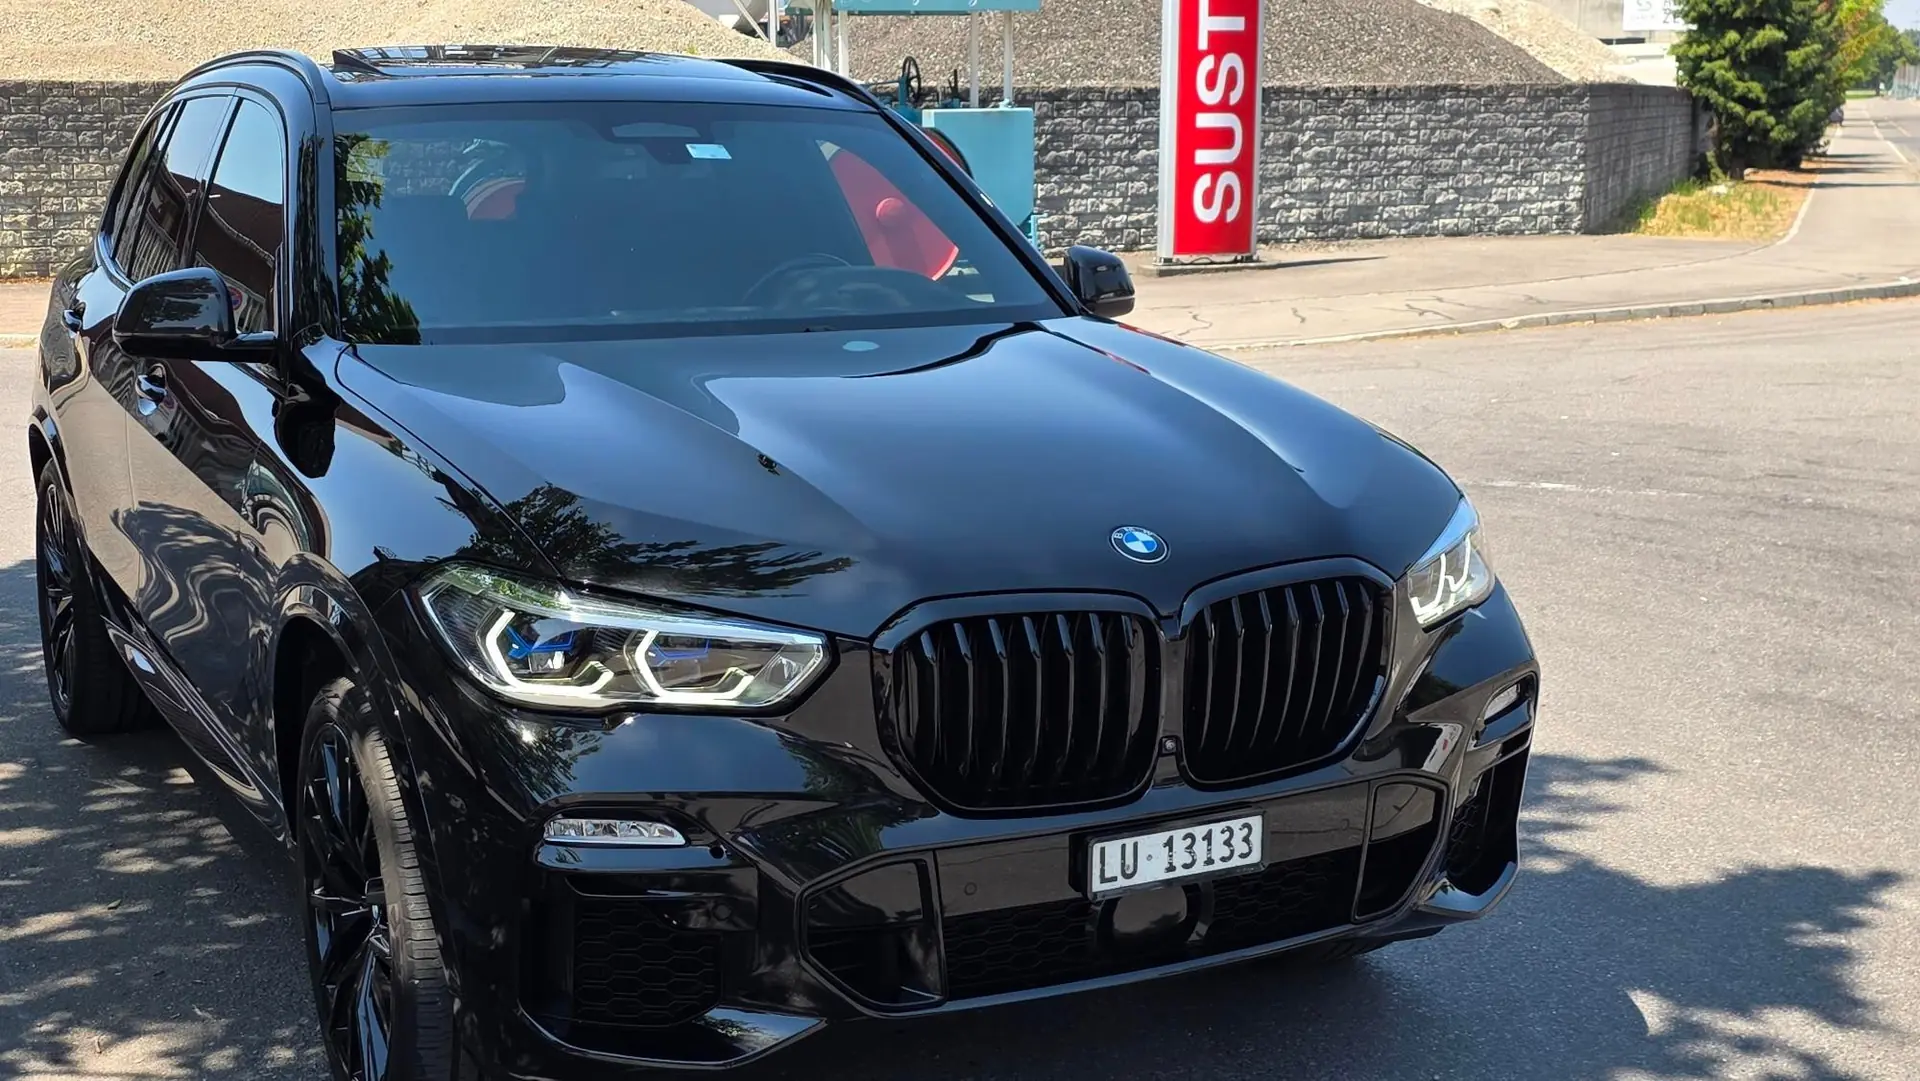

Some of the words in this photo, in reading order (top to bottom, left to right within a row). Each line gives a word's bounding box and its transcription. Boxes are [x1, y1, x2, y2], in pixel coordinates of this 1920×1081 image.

[1193, 0, 1245, 223] SUST
[1099, 841, 1138, 884] LU
[1162, 822, 1253, 873] 13133
